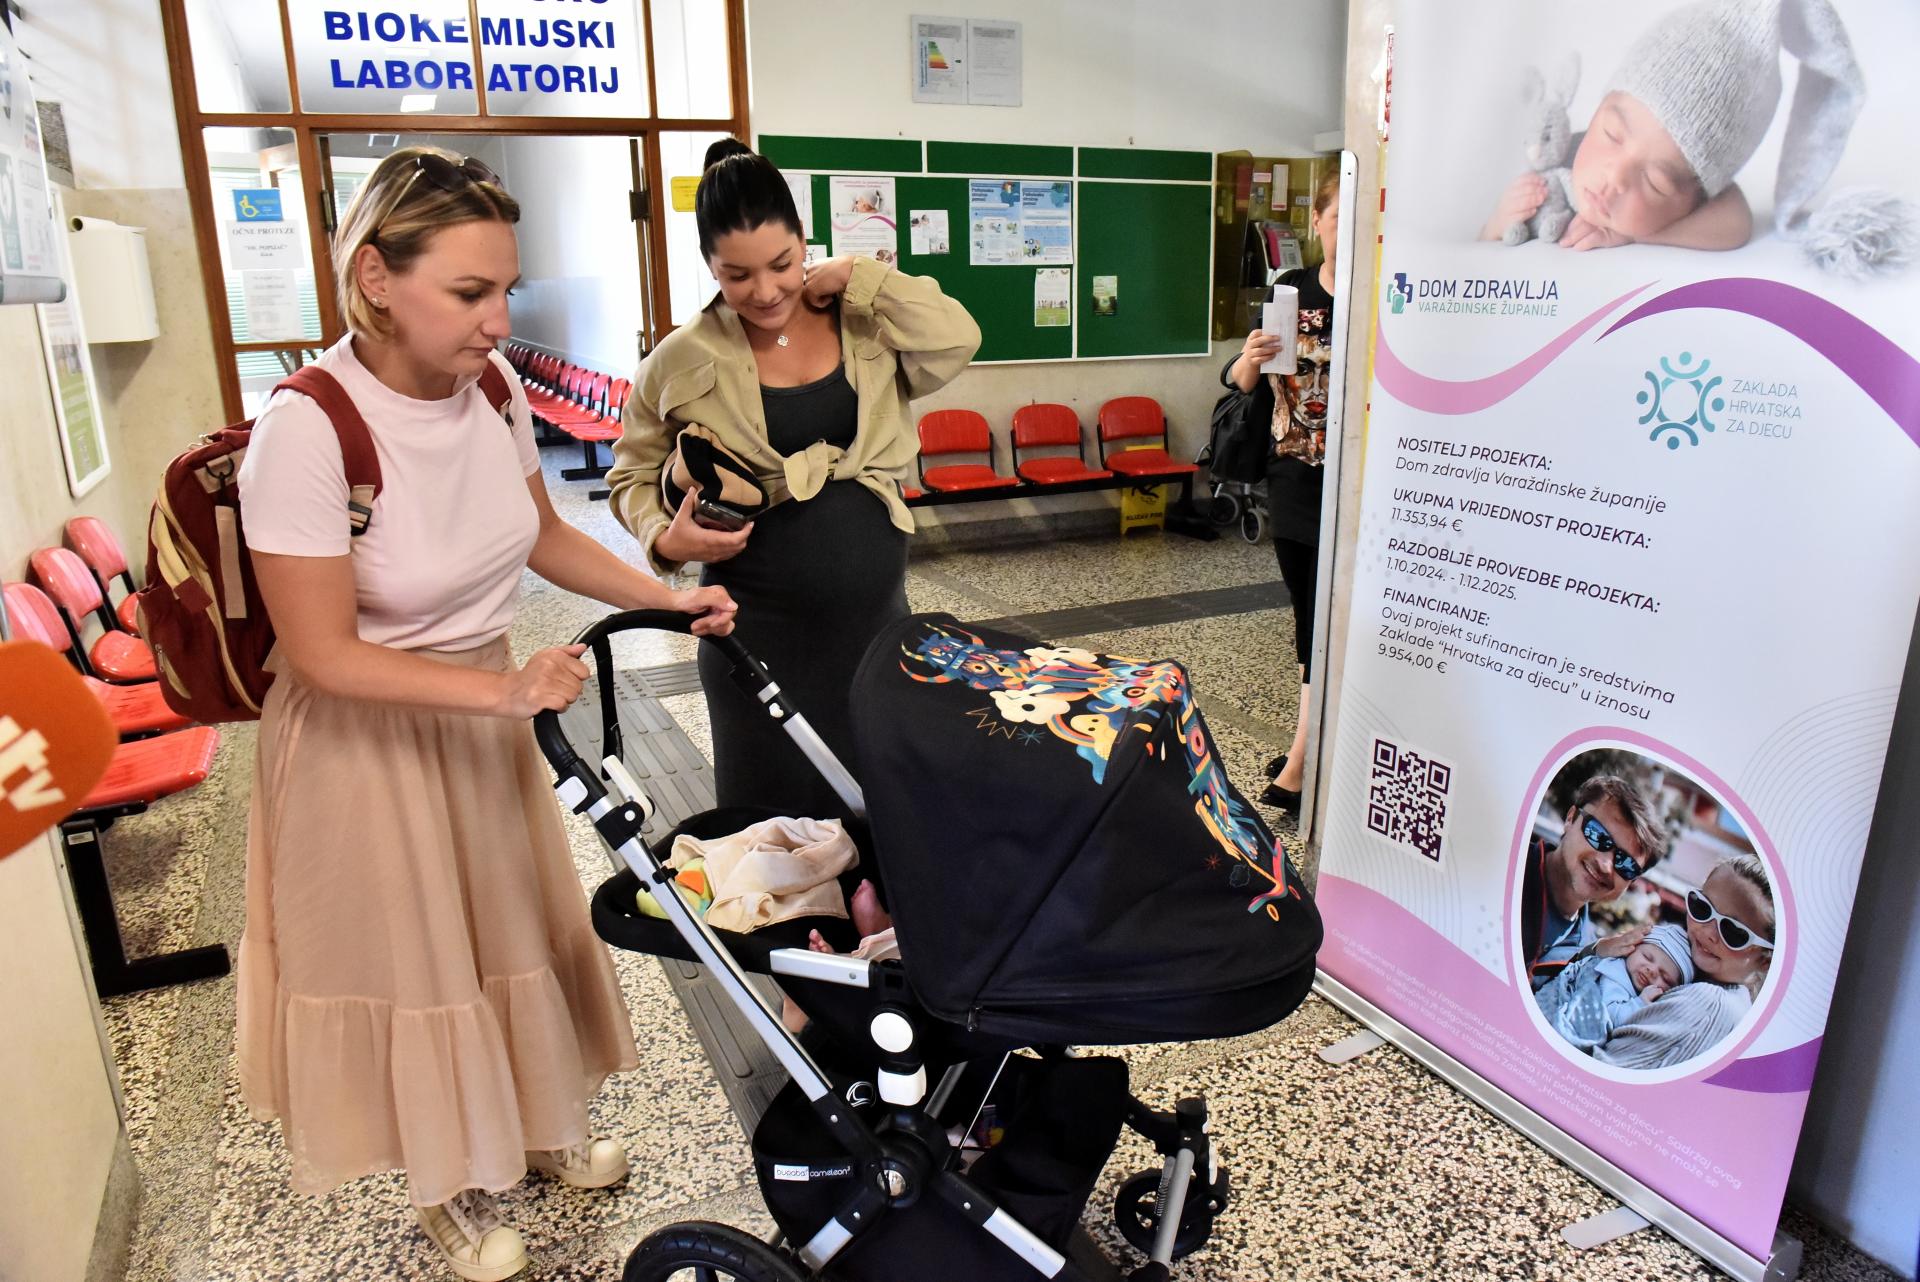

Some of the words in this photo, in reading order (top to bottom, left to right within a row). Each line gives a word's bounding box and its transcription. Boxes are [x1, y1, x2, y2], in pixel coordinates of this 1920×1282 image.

[1419, 280, 1457, 298] DOM
[1462, 280, 1558, 300] ZDRAVLJA
[1418, 300, 1496, 315] VARAŽDINSKE
[1500, 300, 1558, 317] ŽUPANIJE
[1732, 379, 1799, 398] ZAKLADA
[1729, 399, 1801, 419] HRVATSKA
[1726, 418, 1745, 433] ZA
[1748, 421, 1792, 439] DJECU
[1397, 437, 1467, 457] NOSITELJ
[1470, 446, 1552, 470] PROJEKTA:
[1395, 457, 1429, 473] Dom
[1432, 463, 1490, 484] zdravlja
[1495, 471, 1586, 499] Varaždinske
[1589, 487, 1666, 515] županije
[1391, 507, 1447, 528] 11.353,94
[1451, 519, 1464, 532] €
[1393, 488, 1454, 509] UKUPNA
[1460, 499, 1554, 529] VRIJEDNOST
[1556, 518, 1651, 549] PROJEKTA:
[1387, 557, 1446, 581] 1.10.2024.
[1459, 573, 1517, 600] 1.12.2025.
[1388, 538, 1474, 567] RAZDOBLJE
[1477, 557, 1562, 589] PROVEDBE
[1565, 578, 1660, 613] PROJEKTA:
[1383, 588, 1490, 626] FINANCIRANJE:
[1378, 643, 1433, 669] 9.954,00
[1437, 661, 1448, 673] €
[1382, 607, 1413, 627] Ovaj
[1415, 617, 1463, 639] projekt
[1465, 631, 1557, 668] sufinanciran
[1558, 657, 1576, 674] je
[1579, 665, 1675, 703] sredstvima
[1379, 625, 1434, 650] Zaklade
[1506, 665, 1524, 679] za
[1580, 688, 1591, 701] u
[1595, 690, 1651, 720] iznosu
[1713, 1166, 1743, 1190] ovog
